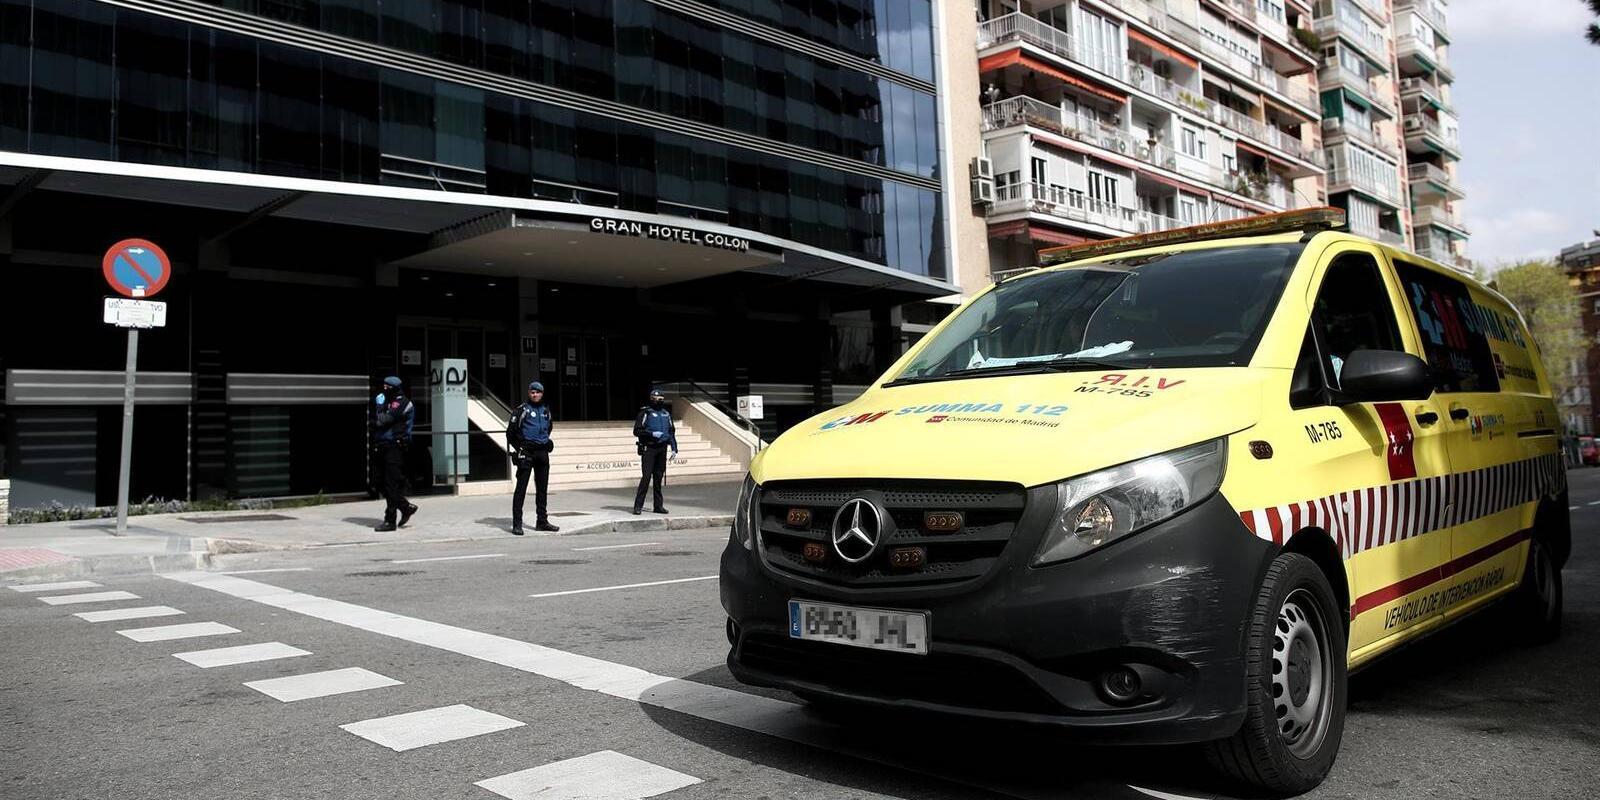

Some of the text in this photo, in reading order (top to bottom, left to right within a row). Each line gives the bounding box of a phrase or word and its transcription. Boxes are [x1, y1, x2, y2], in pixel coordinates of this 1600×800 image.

[591, 217, 750, 250] GRAN HOTEL COLON
[1073, 386, 1154, 398] M-785
[894, 402, 1069, 416] SUMMA 112
[946, 415, 1061, 429] Comunidad de Madrid
[1304, 421, 1342, 444] M-785
[586, 462, 611, 470] ACCESO
[1383, 596, 1427, 630] VEHÍCULO
[1426, 591, 1441, 613] DE
